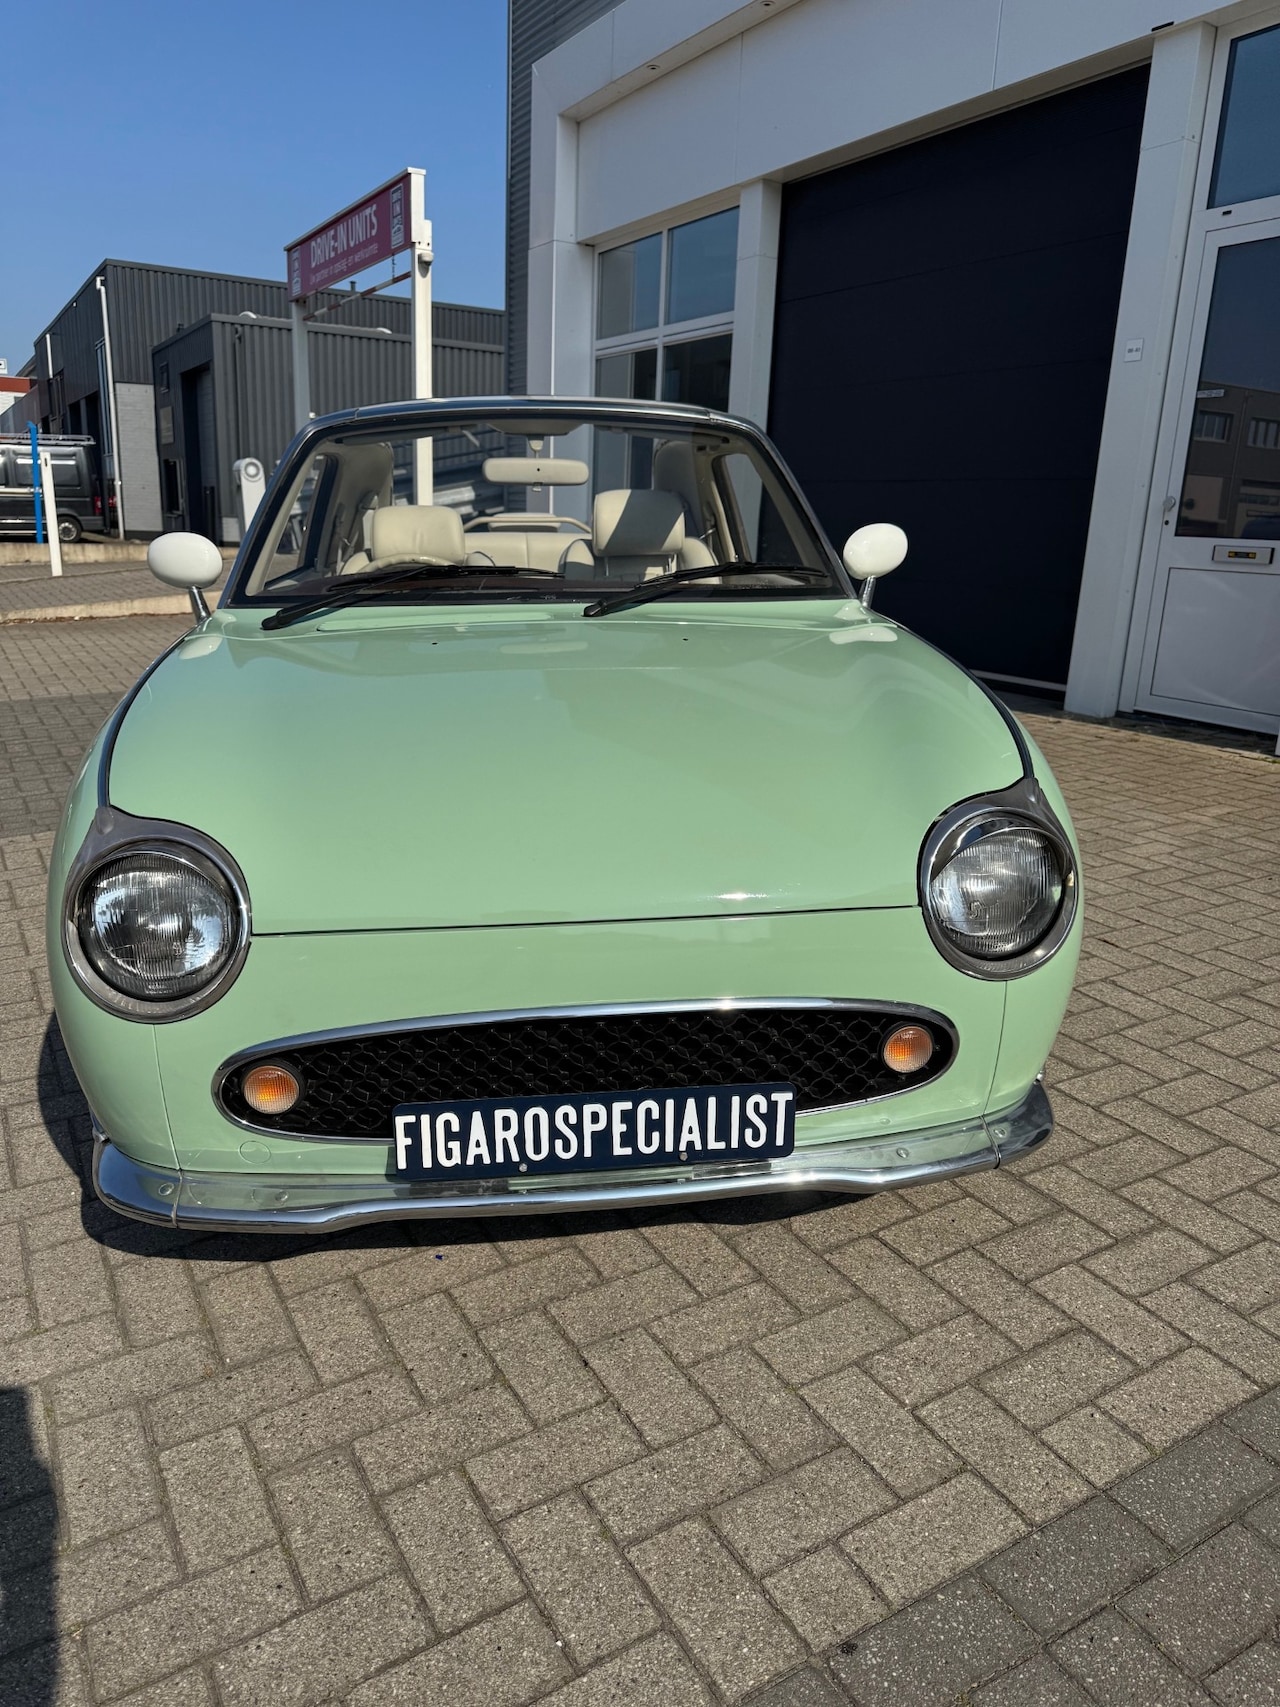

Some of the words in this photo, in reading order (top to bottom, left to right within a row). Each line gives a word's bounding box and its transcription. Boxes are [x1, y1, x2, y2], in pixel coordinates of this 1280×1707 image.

[310, 222, 347, 268] DRIVE-IN
[348, 204, 378, 247] UNITS
[395, 1092, 793, 1169] FIGAROSPECIALIST
